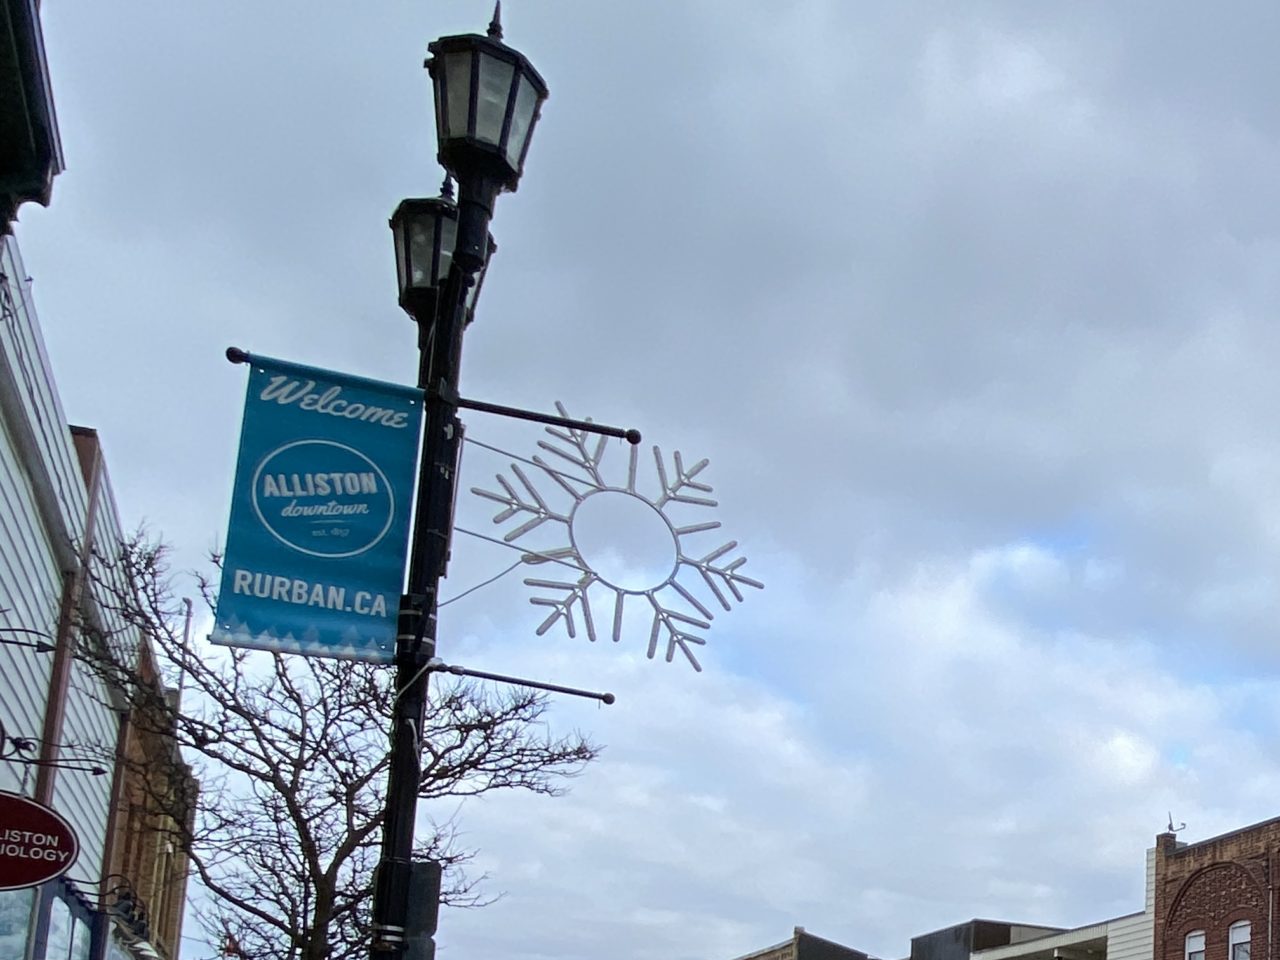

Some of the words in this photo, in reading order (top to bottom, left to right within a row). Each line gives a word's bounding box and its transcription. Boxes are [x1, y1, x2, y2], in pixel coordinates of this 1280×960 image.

[259, 375, 408, 428] Welcome
[264, 472, 378, 498] ALLISTON
[281, 500, 369, 517] downtown
[233, 569, 387, 618] RURBAN.CA
